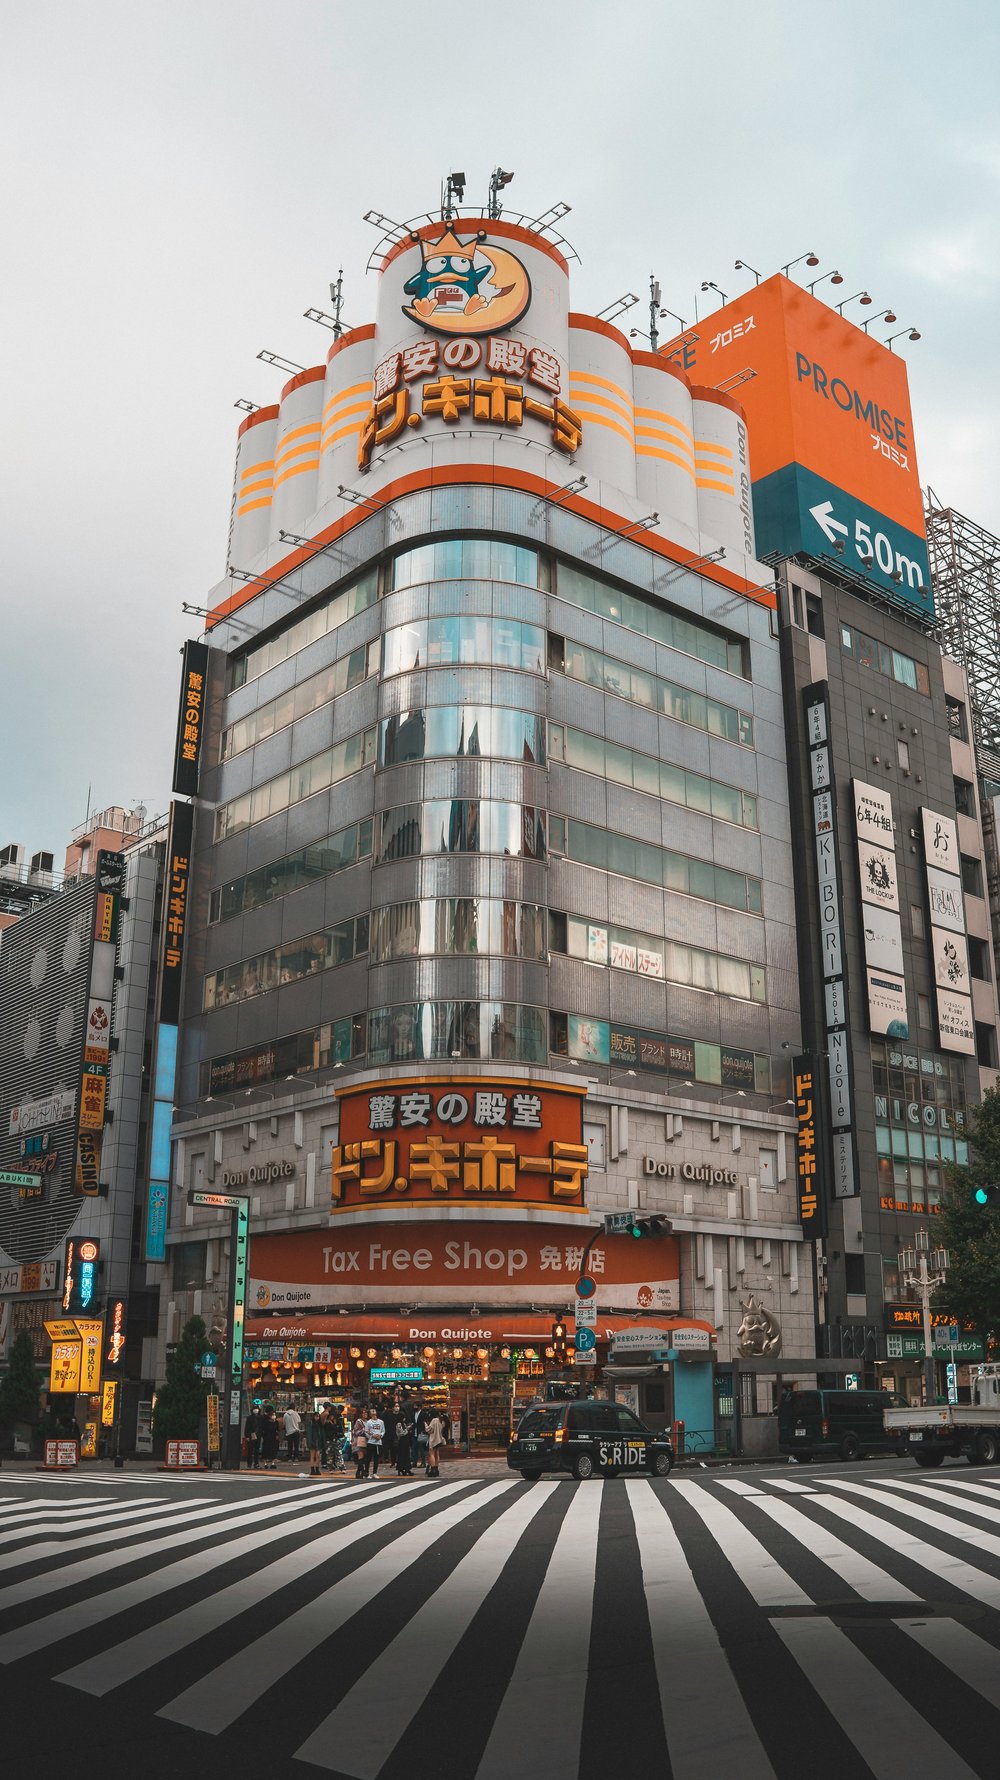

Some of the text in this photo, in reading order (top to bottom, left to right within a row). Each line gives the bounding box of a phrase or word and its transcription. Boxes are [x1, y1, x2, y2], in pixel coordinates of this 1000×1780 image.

[709, 315, 757, 354] プロミス
[374, 337, 562, 401] 驚安の殿堂
[795, 351, 908, 451] PROMISE
[869, 433, 911, 472] プロミス
[736, 420, 752, 555] Don Quijote
[854, 518, 924, 589] 50m
[182, 671, 203, 761] 驚安の殿堂
[815, 753, 825, 785] おかか
[857, 805, 893, 832] 6年4組
[820, 839, 838, 970] KIBORI
[866, 886, 875, 895] THE
[876, 889, 895, 901] LOCKUP
[612, 945, 637, 970] アイドル
[639, 952, 661, 975] ステージ
[831, 983, 840, 1025] ESOLA
[610, 1032, 636, 1055] 販売
[640, 1042, 666, 1057] ブランド
[669, 1047, 694, 1062] 時計
[88, 1064, 104, 1074] 4F
[832, 1034, 846, 1118] Nicole
[890, 1052, 918, 1071] SPICE
[84, 1077, 104, 1113] 麻雀
[368, 1092, 543, 1130] 驚安の殿堂
[875, 1096, 964, 1129] NICOLE
[79, 1132, 98, 1192] CASINO
[222, 1161, 294, 1187] Don Quijote
[642, 1156, 740, 1187] Don Quijote
[839, 1136, 848, 1193] ミステリアス
[195, 1195, 223, 1204] CENTRAL
[43, 1263, 56, 1275] 入口
[322, 1241, 528, 1277] Tax Free Shop
[538, 1244, 606, 1274] 免税店
[235, 1235, 247, 1347] ゴジラロード
[271, 1291, 311, 1304] Don Quijote
[79, 1323, 102, 1332] カラオケ
[262, 1326, 308, 1340] Don Quijote
[409, 1328, 492, 1342] Don Quijote
[579, 1333, 588, 1348] P
[54, 1344, 80, 1360] カラオケ
[600, 1447, 646, 1466] S.RIDE
